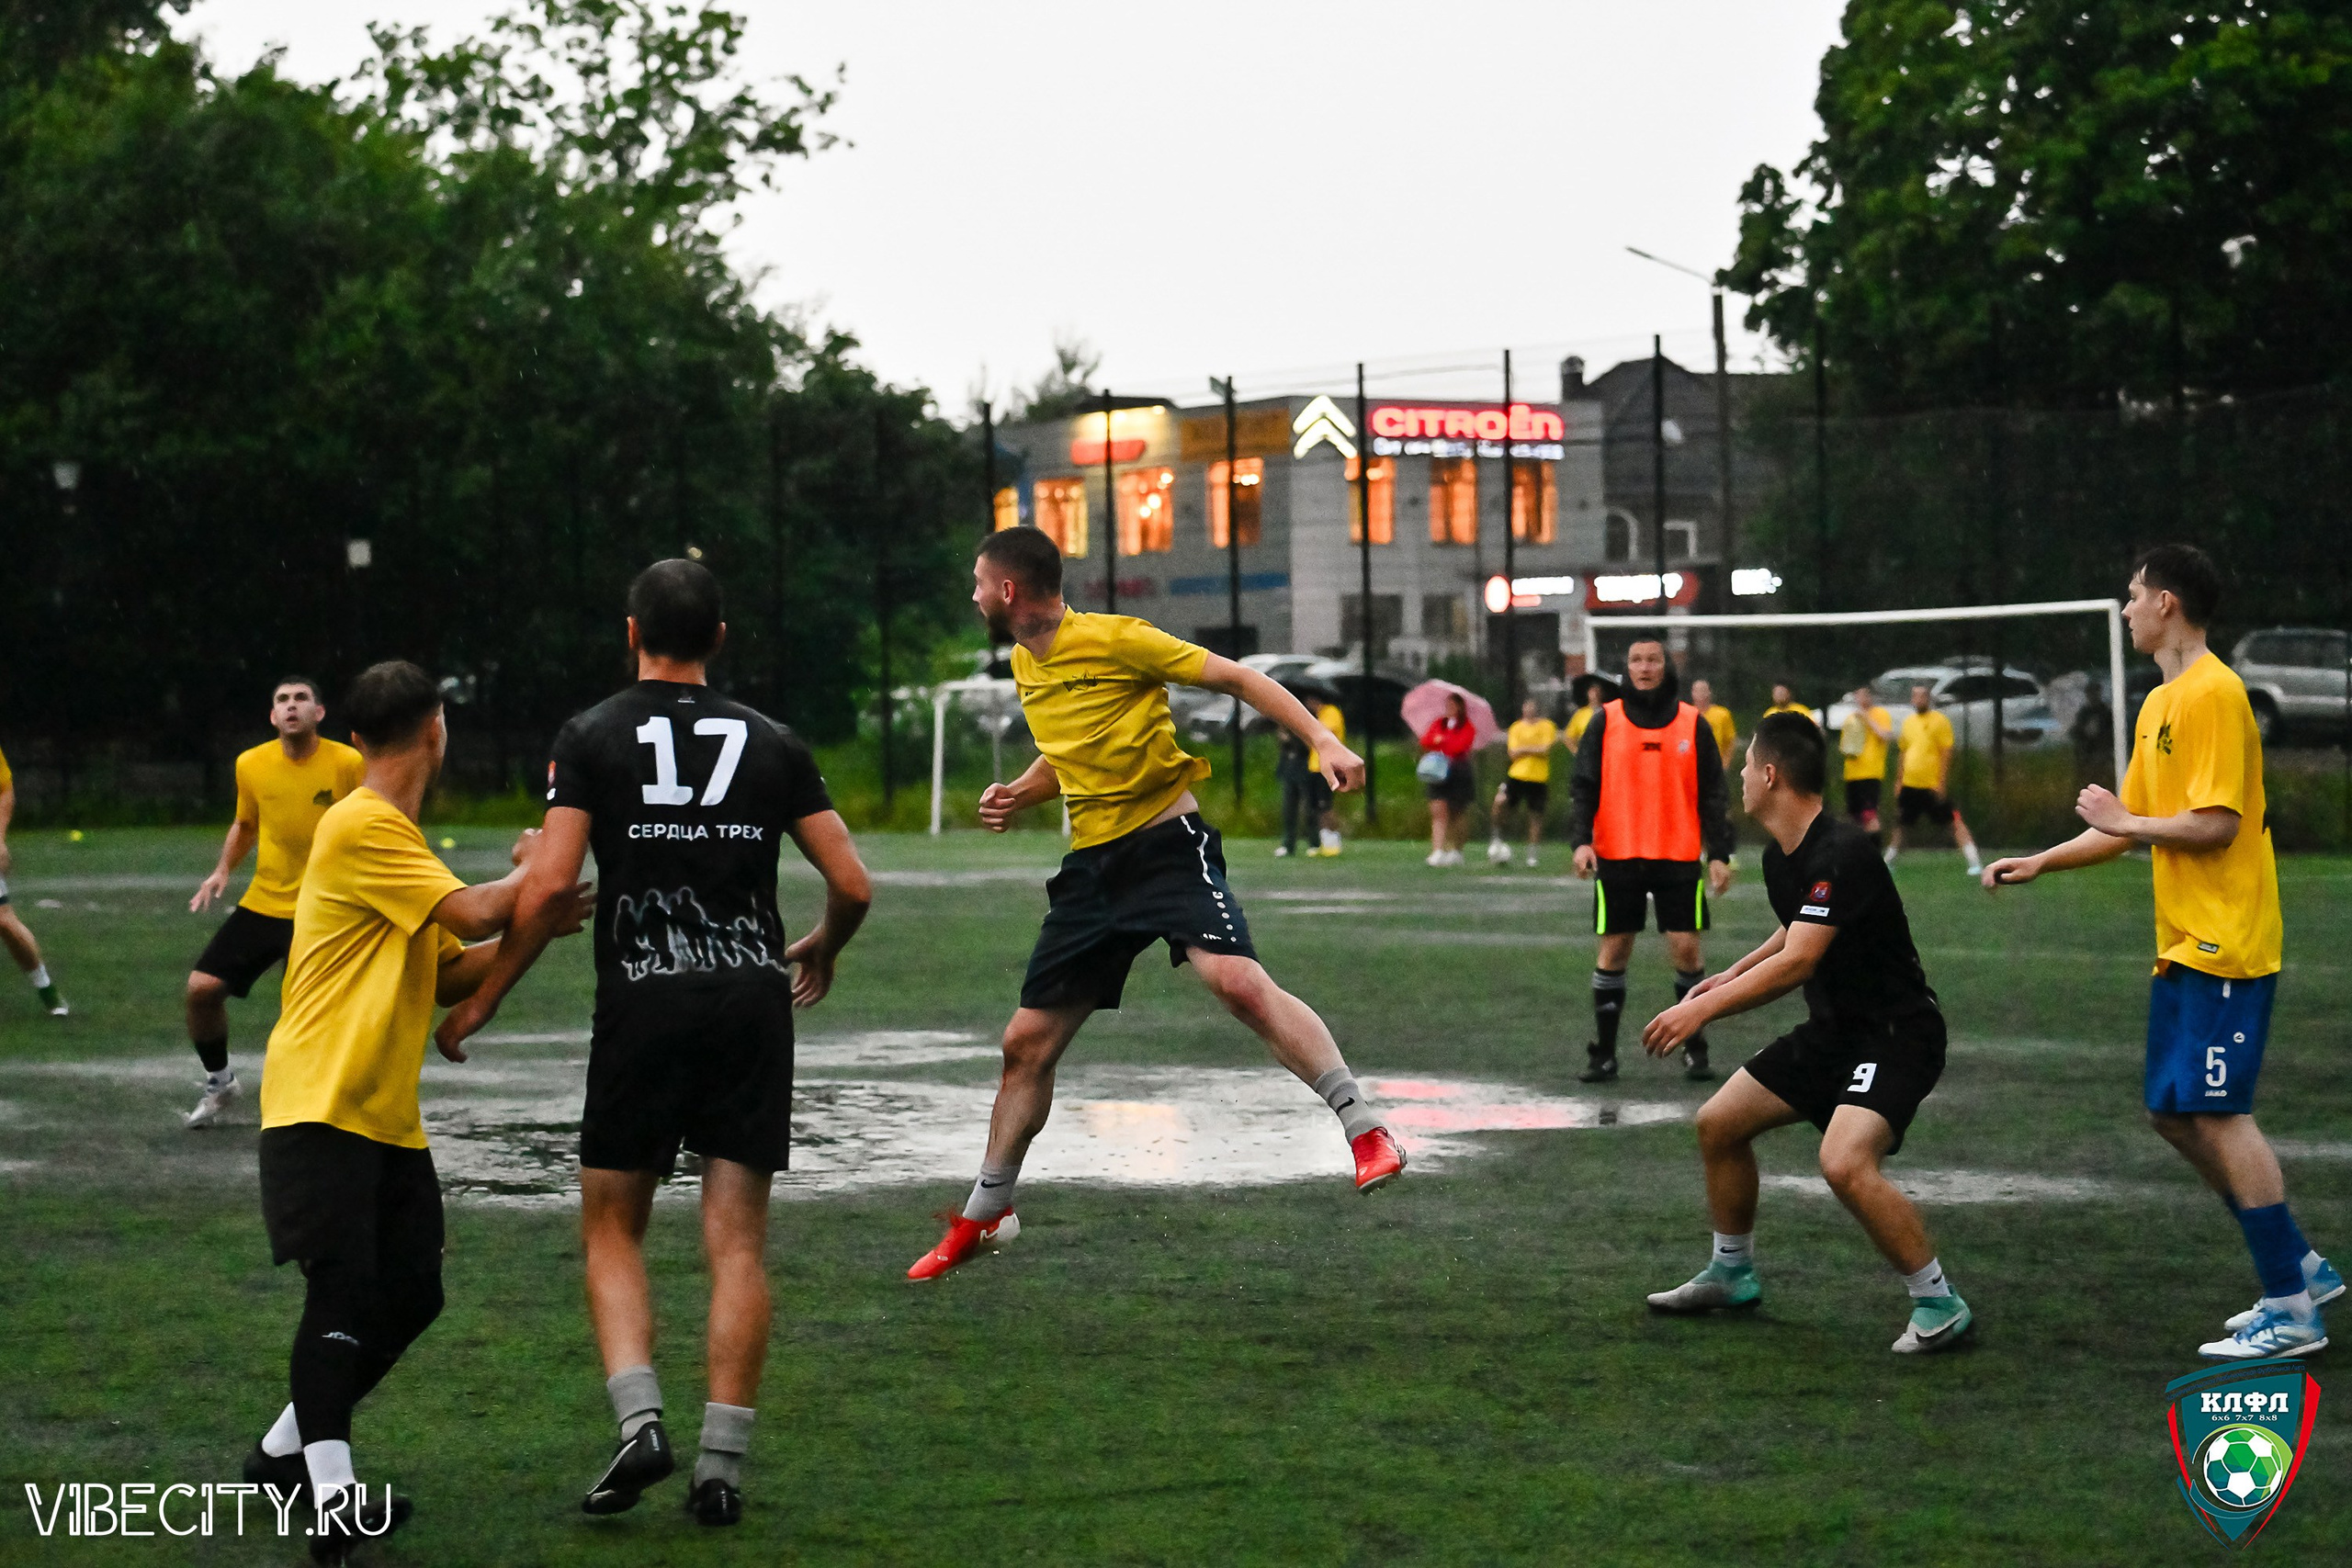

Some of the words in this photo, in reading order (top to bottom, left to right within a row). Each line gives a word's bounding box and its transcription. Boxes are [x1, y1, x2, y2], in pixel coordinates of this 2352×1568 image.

[637, 716, 748, 807] 17
[628, 823, 709, 841] СЕРДЦА
[716, 824, 764, 840] ТРЕХ
[1847, 1062, 1878, 1093] 9
[2205, 1046, 2227, 1088] 5
